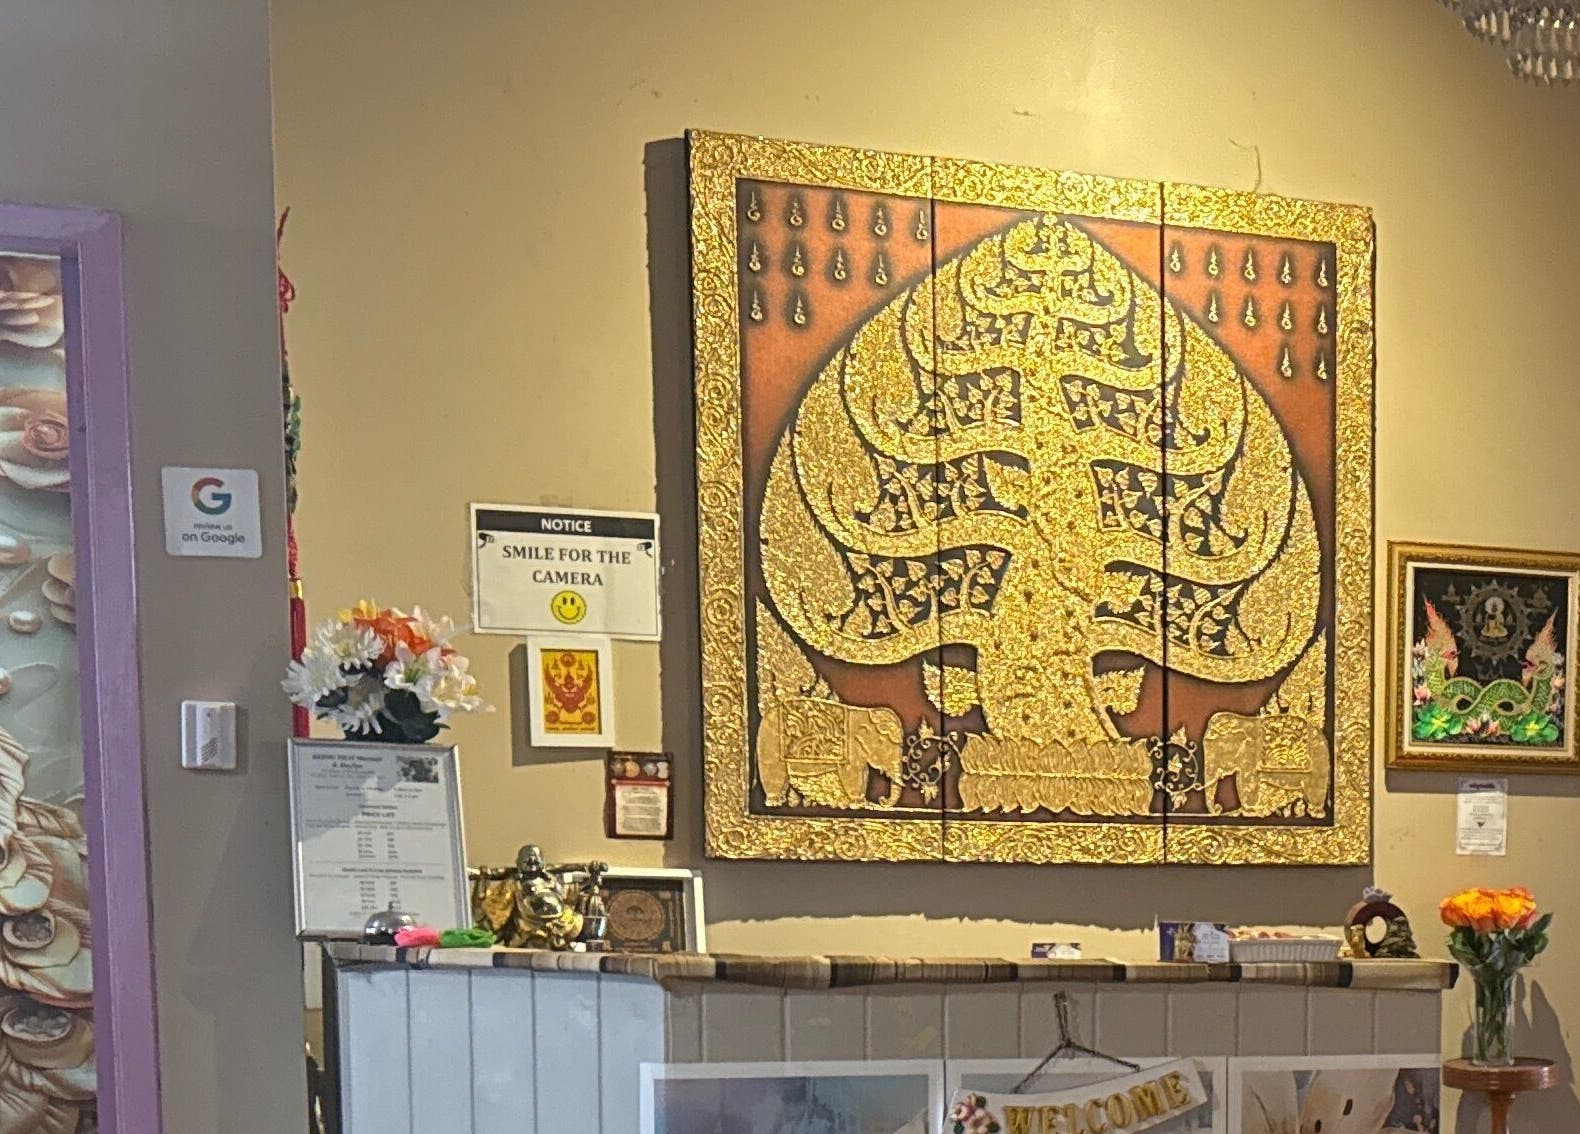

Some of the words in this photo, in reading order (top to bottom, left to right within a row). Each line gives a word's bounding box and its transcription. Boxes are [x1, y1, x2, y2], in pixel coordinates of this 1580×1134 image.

[541, 518, 592, 532] NOTICE
[181, 533, 198, 541] on
[201, 531, 245, 544] Google
[502, 545, 554, 560] SMILE
[559, 548, 592, 562] FOR
[597, 551, 631, 564] THE
[533, 570, 603, 585] CAMERA
